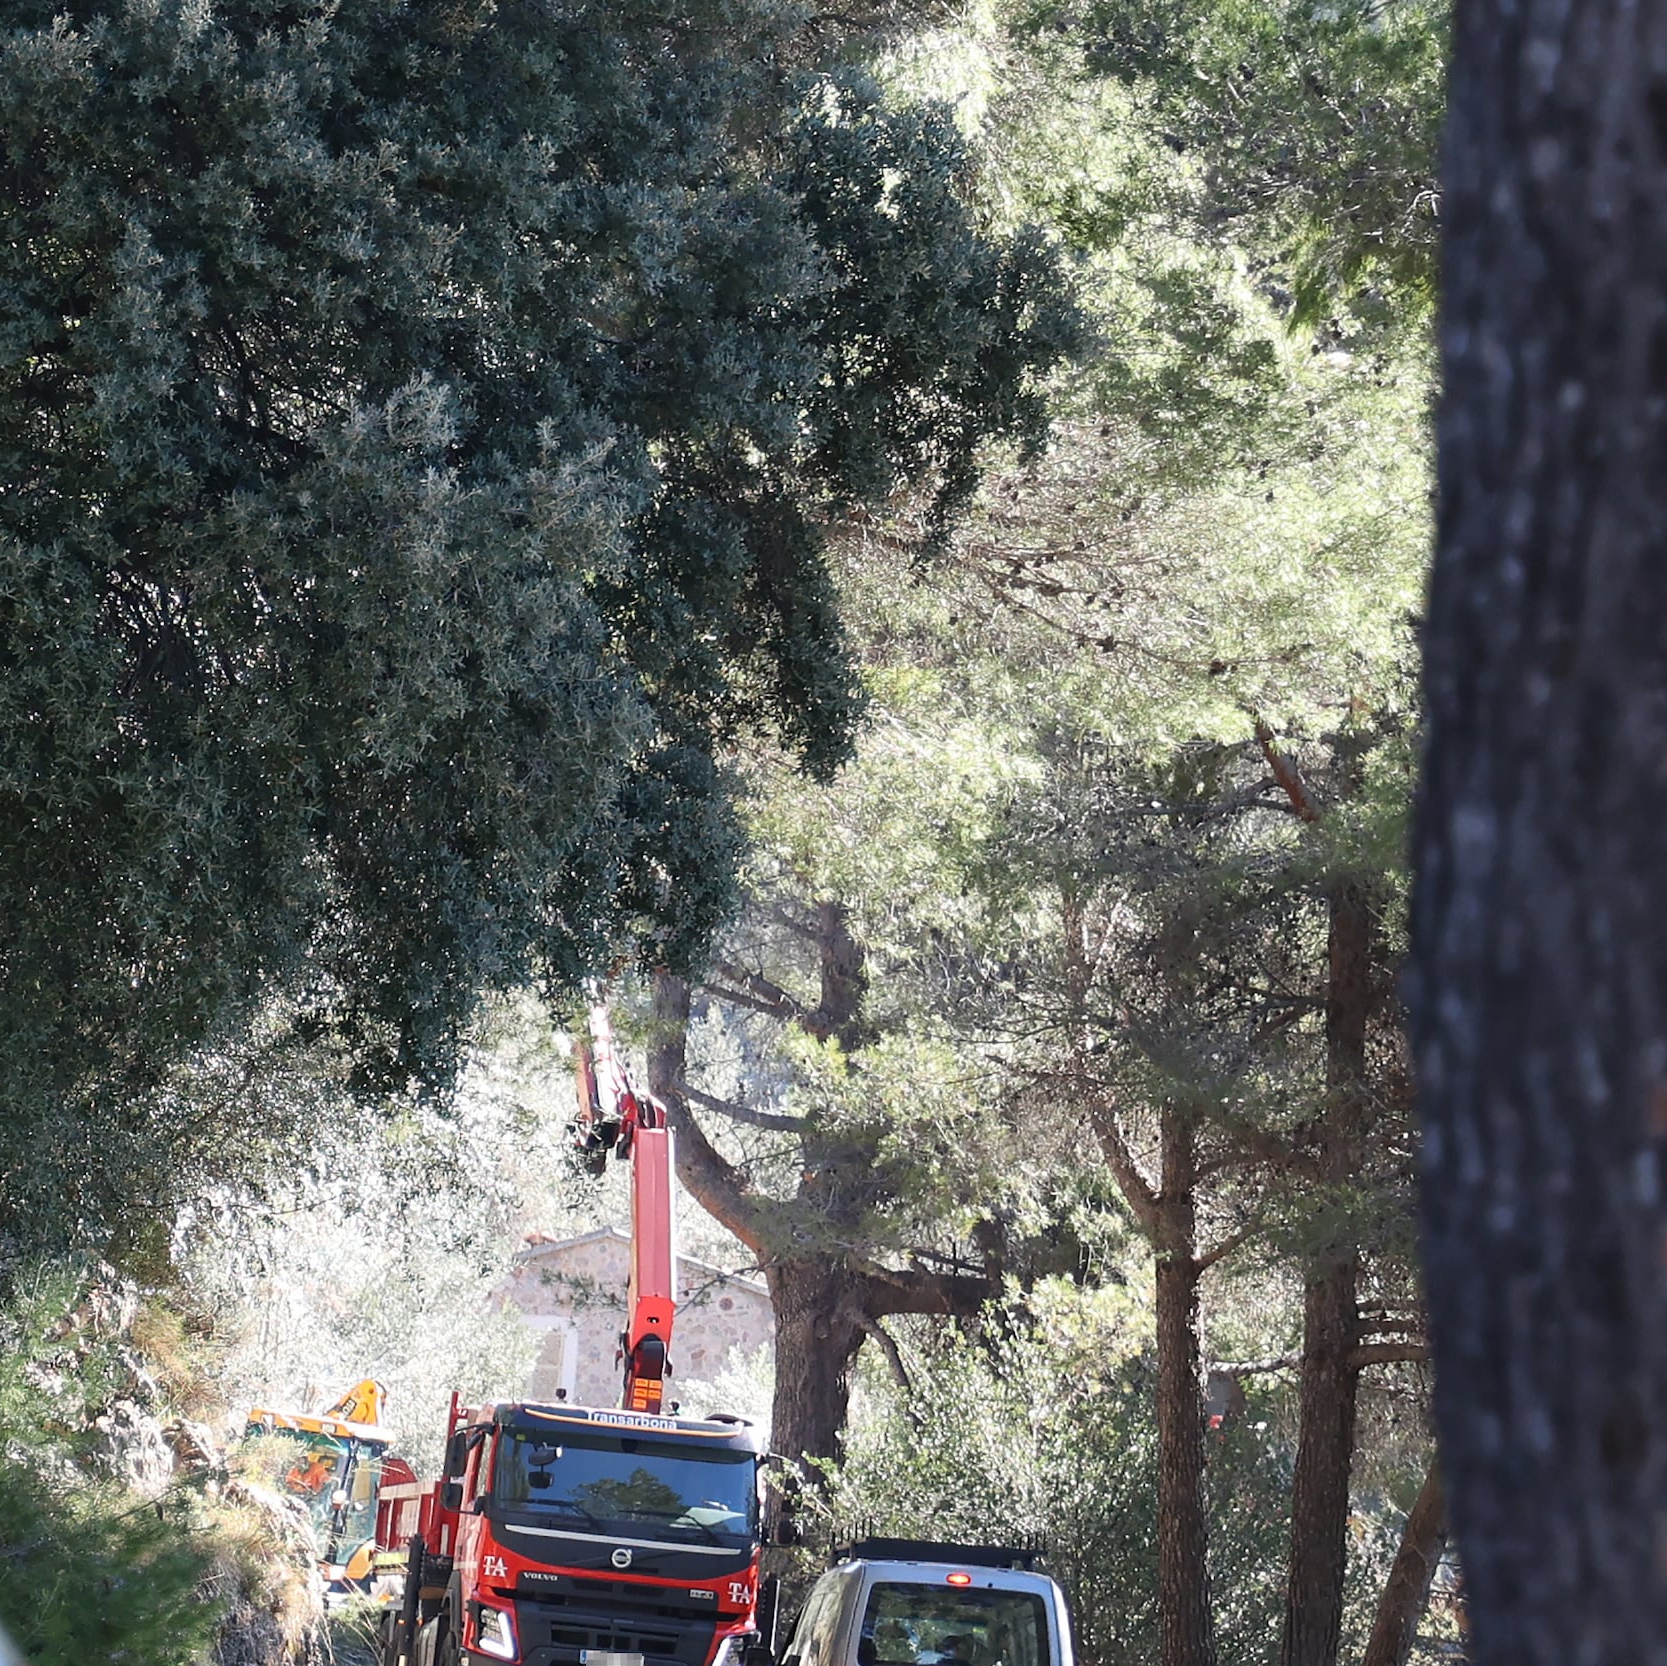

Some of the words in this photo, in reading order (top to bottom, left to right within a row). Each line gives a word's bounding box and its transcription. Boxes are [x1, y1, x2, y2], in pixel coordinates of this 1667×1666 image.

[587, 1411, 678, 1430] Transarbona
[483, 1555, 508, 1578] TA
[523, 1571, 559, 1582] VOLVO
[728, 1582, 751, 1604] TA
